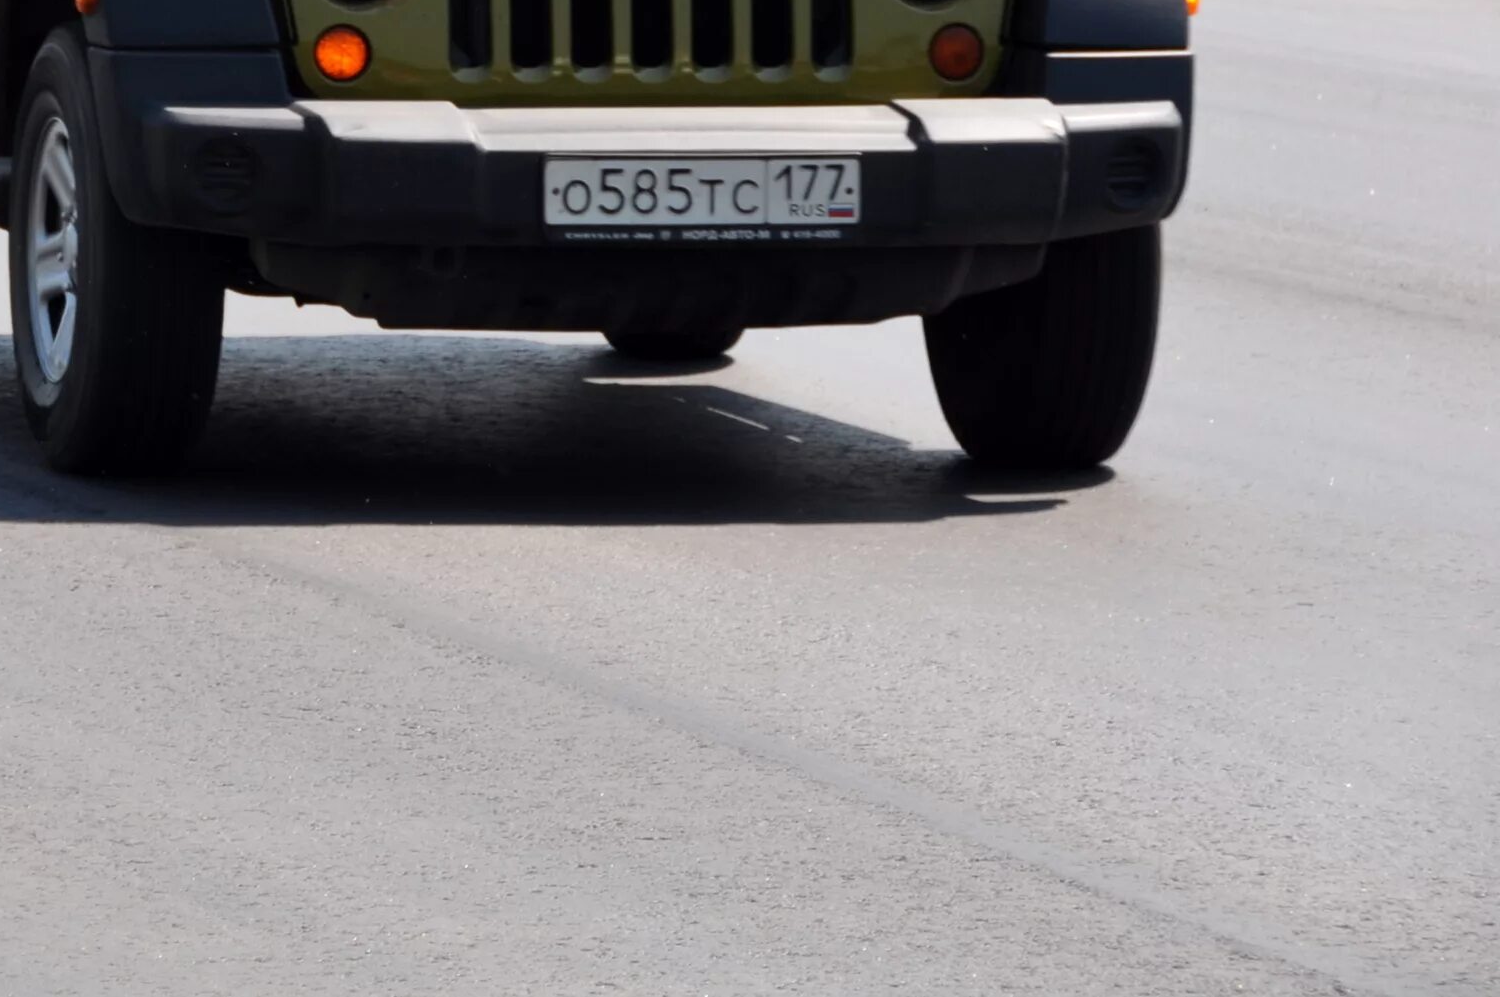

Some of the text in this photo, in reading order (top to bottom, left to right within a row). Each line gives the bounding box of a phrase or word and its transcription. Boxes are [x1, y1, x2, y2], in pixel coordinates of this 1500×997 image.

[562, 164, 846, 216] О585ТС 177
[789, 204, 826, 217] RUS
